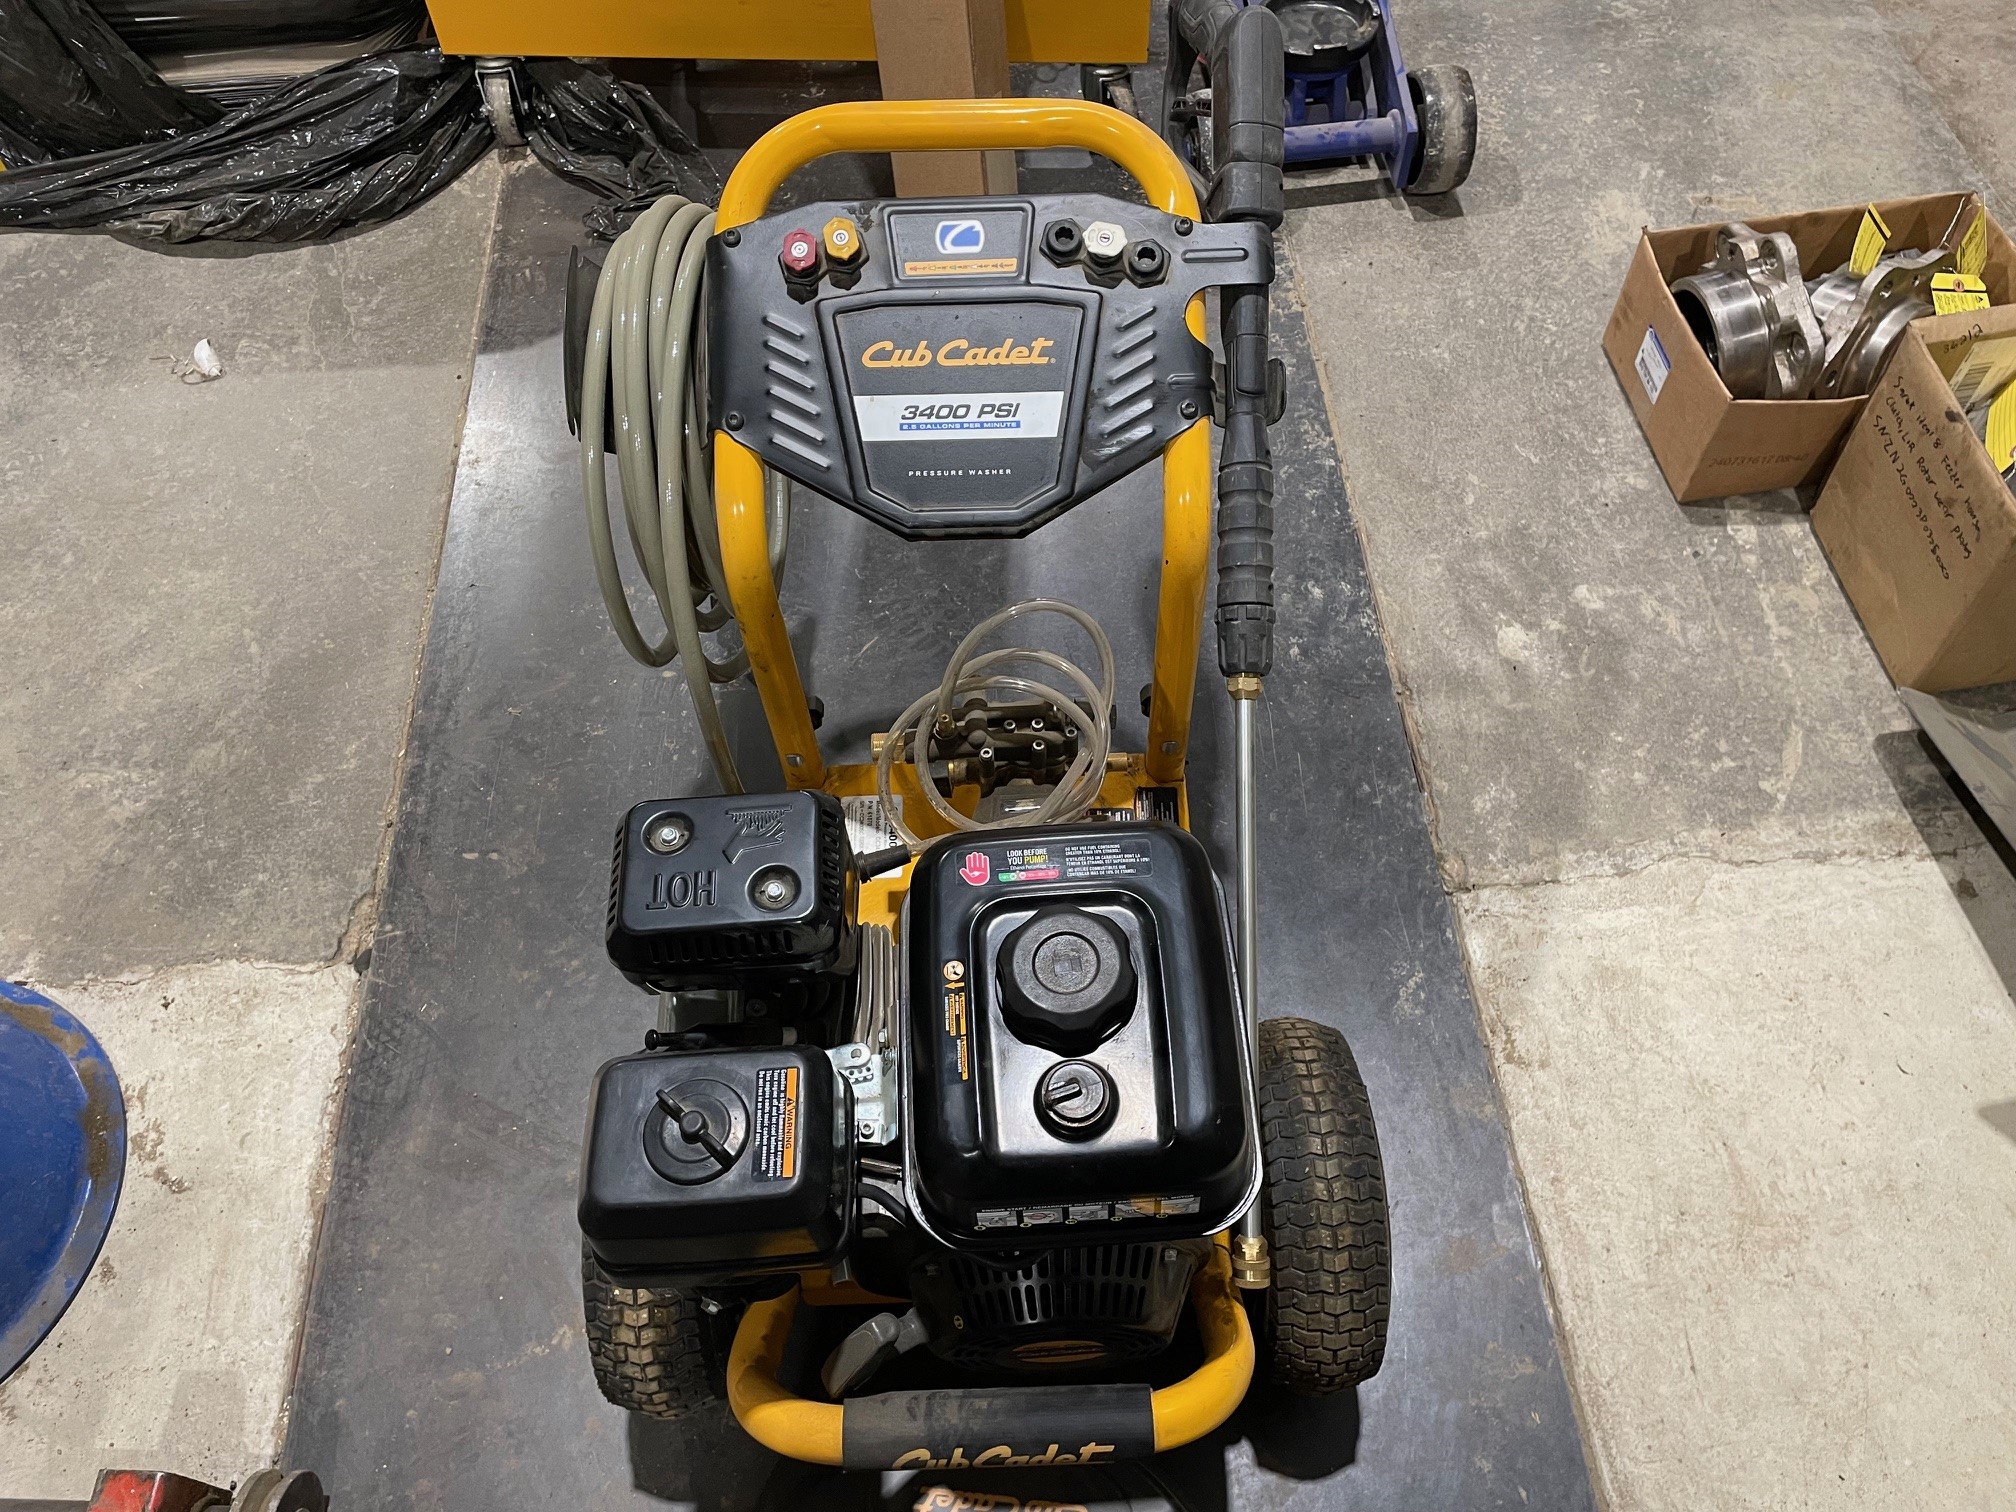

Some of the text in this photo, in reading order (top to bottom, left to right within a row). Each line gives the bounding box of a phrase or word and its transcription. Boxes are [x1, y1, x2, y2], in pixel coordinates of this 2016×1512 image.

[861, 337, 1054, 368] Cub Cadet
[901, 402, 1020, 420] 3400 PSI
[1007, 855, 1048, 865] YOU PUMP!
[646, 868, 718, 910] HOT
[786, 1107, 794, 1150] WARNING
[892, 1442, 1115, 1470] Cub Cadet
